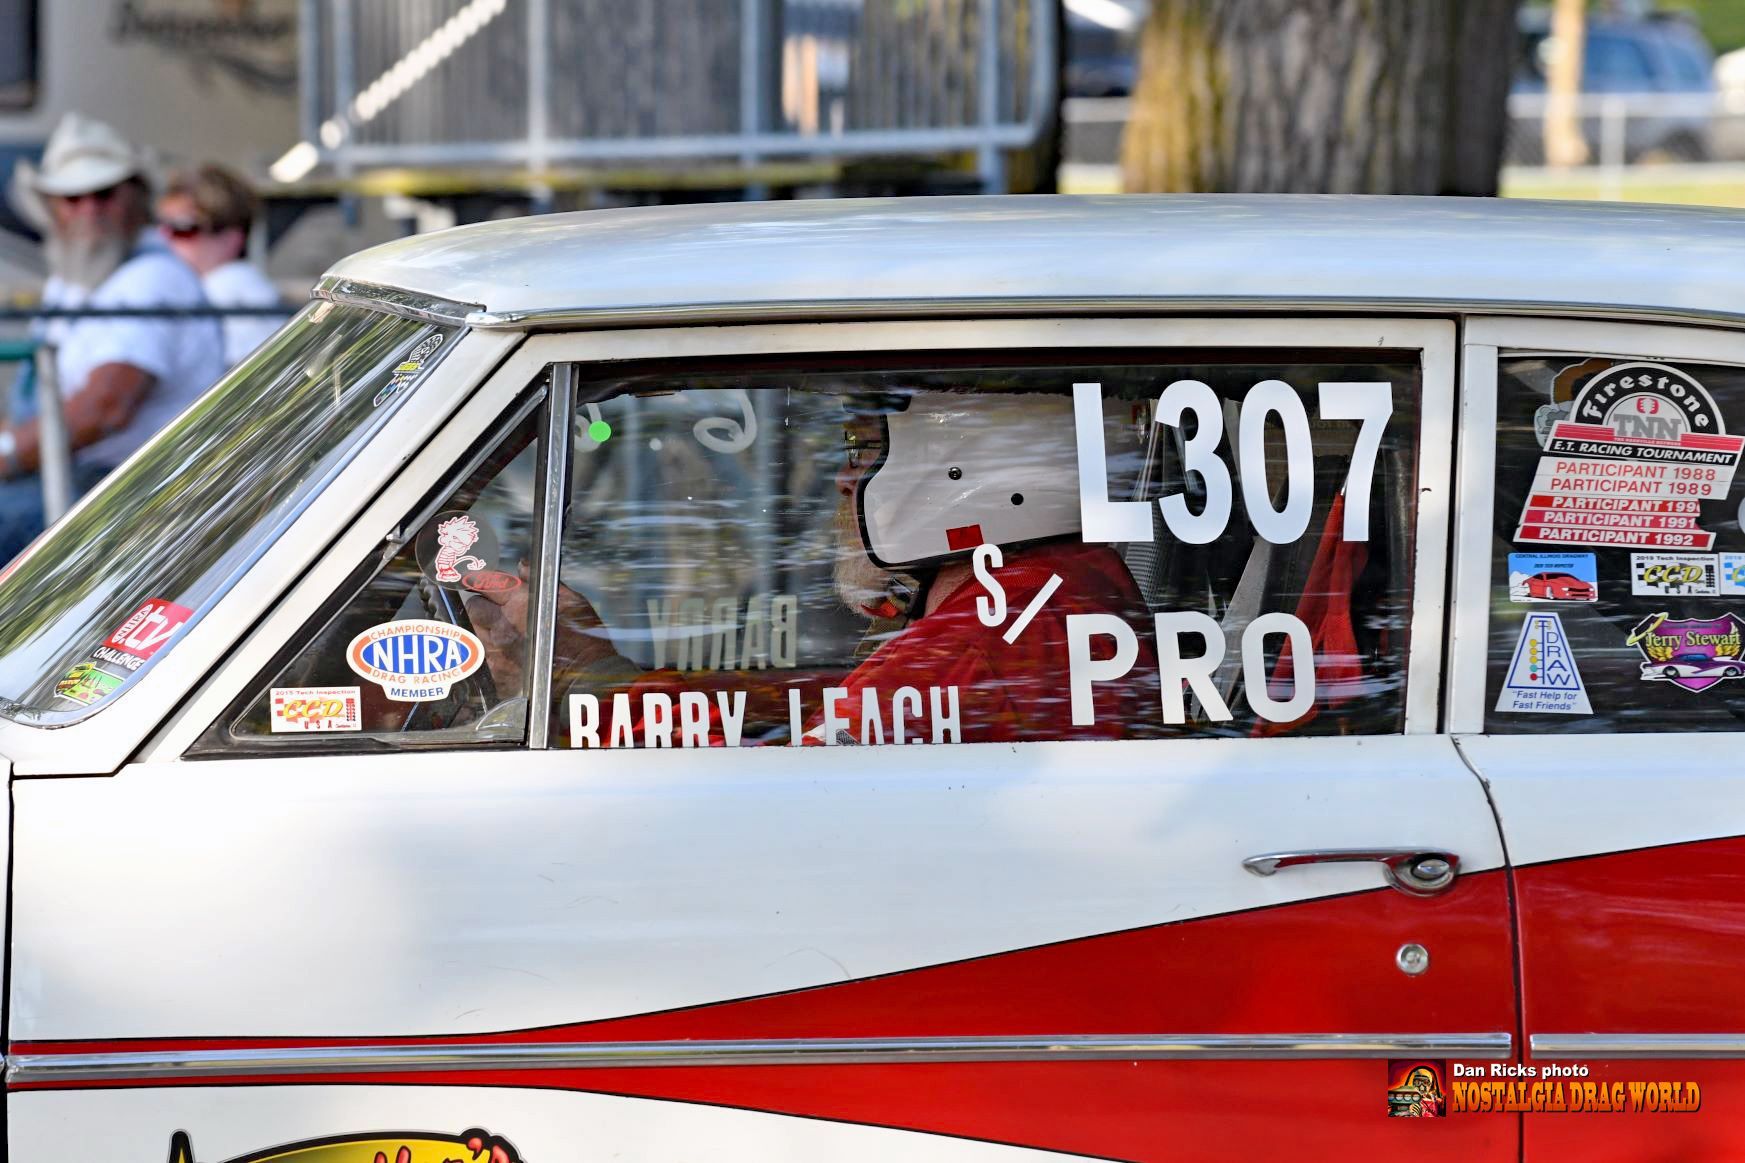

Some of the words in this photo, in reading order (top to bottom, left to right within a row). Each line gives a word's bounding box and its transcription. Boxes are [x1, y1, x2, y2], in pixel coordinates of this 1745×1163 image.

[1582, 374, 1710, 427] Firestone
[1613, 413, 1681, 441] TNN
[1072, 379, 1394, 545] L307
[1553, 442, 1575, 452] E.T.
[1579, 444, 1633, 457] RACING
[1636, 447, 1733, 464] TOURNAMENT
[1556, 461, 1668, 479] PARTICIPANT
[1674, 467, 1716, 481] 1988
[1551, 478, 1662, 494] PARTICIPANT
[1669, 483, 1712, 496] 1989
[1552, 496, 1663, 512] PARTICIPANT
[1544, 512, 1653, 527] PARTICIPANT
[1659, 516, 1696, 529] 1991
[1539, 528, 1649, 544] PARTICIPANT
[1655, 532, 1693, 546] 1992
[1643, 565, 1703, 583] CCD
[370, 624, 461, 641] CHAMPIONSHIP
[1646, 632, 1682, 650] Jerry
[1686, 631, 1741, 646] Stewart
[93, 647, 145, 670] CHALLENGE
[372, 635, 463, 674] NHRA
[371, 669, 407, 684] DRAG
[413, 668, 461, 685] RACING
[1066, 612, 1316, 726] PRO
[390, 686, 444, 698] MEMBER
[1540, 691, 1561, 702] Help
[1563, 692, 1577, 700] for
[283, 700, 343, 718] CCD
[1513, 701, 1532, 709] Fast
